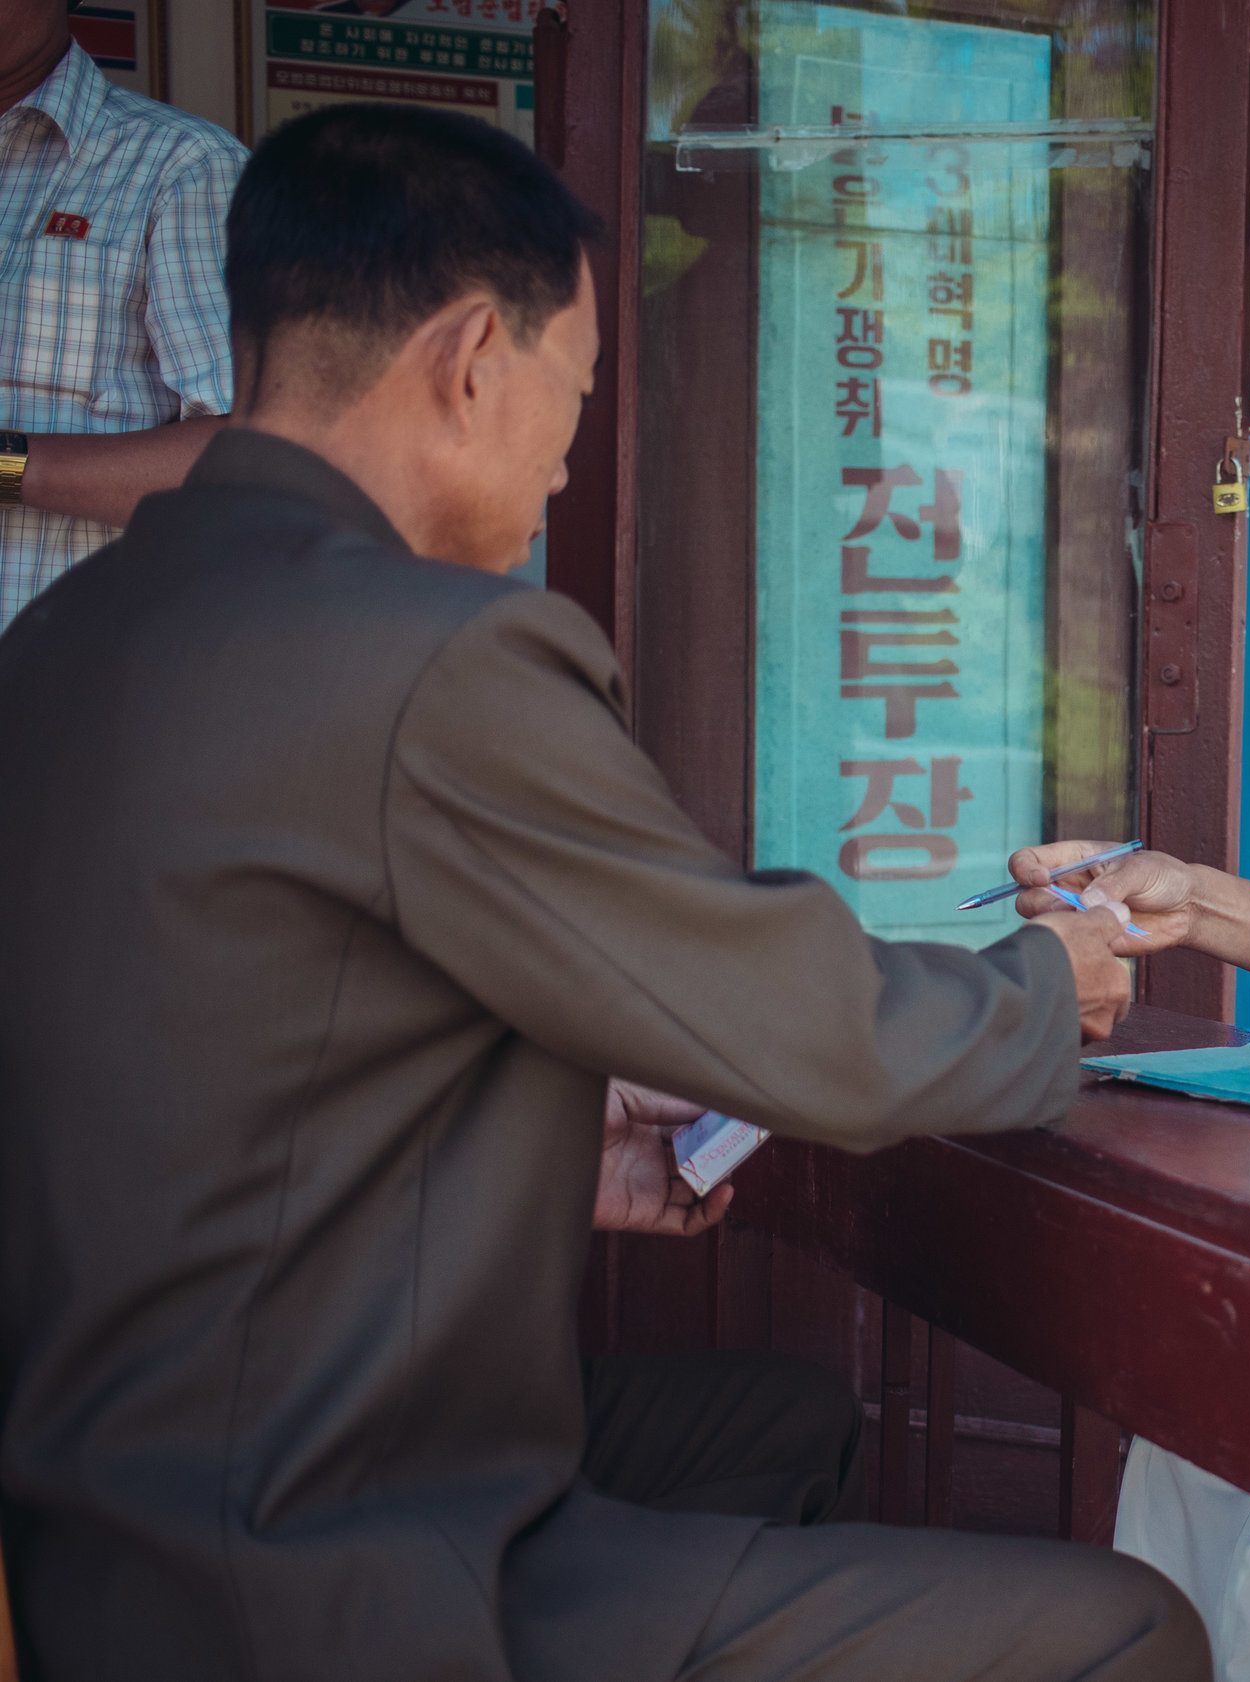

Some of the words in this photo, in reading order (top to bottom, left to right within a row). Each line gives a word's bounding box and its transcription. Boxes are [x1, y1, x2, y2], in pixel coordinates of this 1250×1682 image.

[344, 26, 393, 43] 사회에
[405, 31, 469, 50] 자각적인
[926, 142, 974, 398] 3대혁명
[837, 463, 974, 882] 전투장
